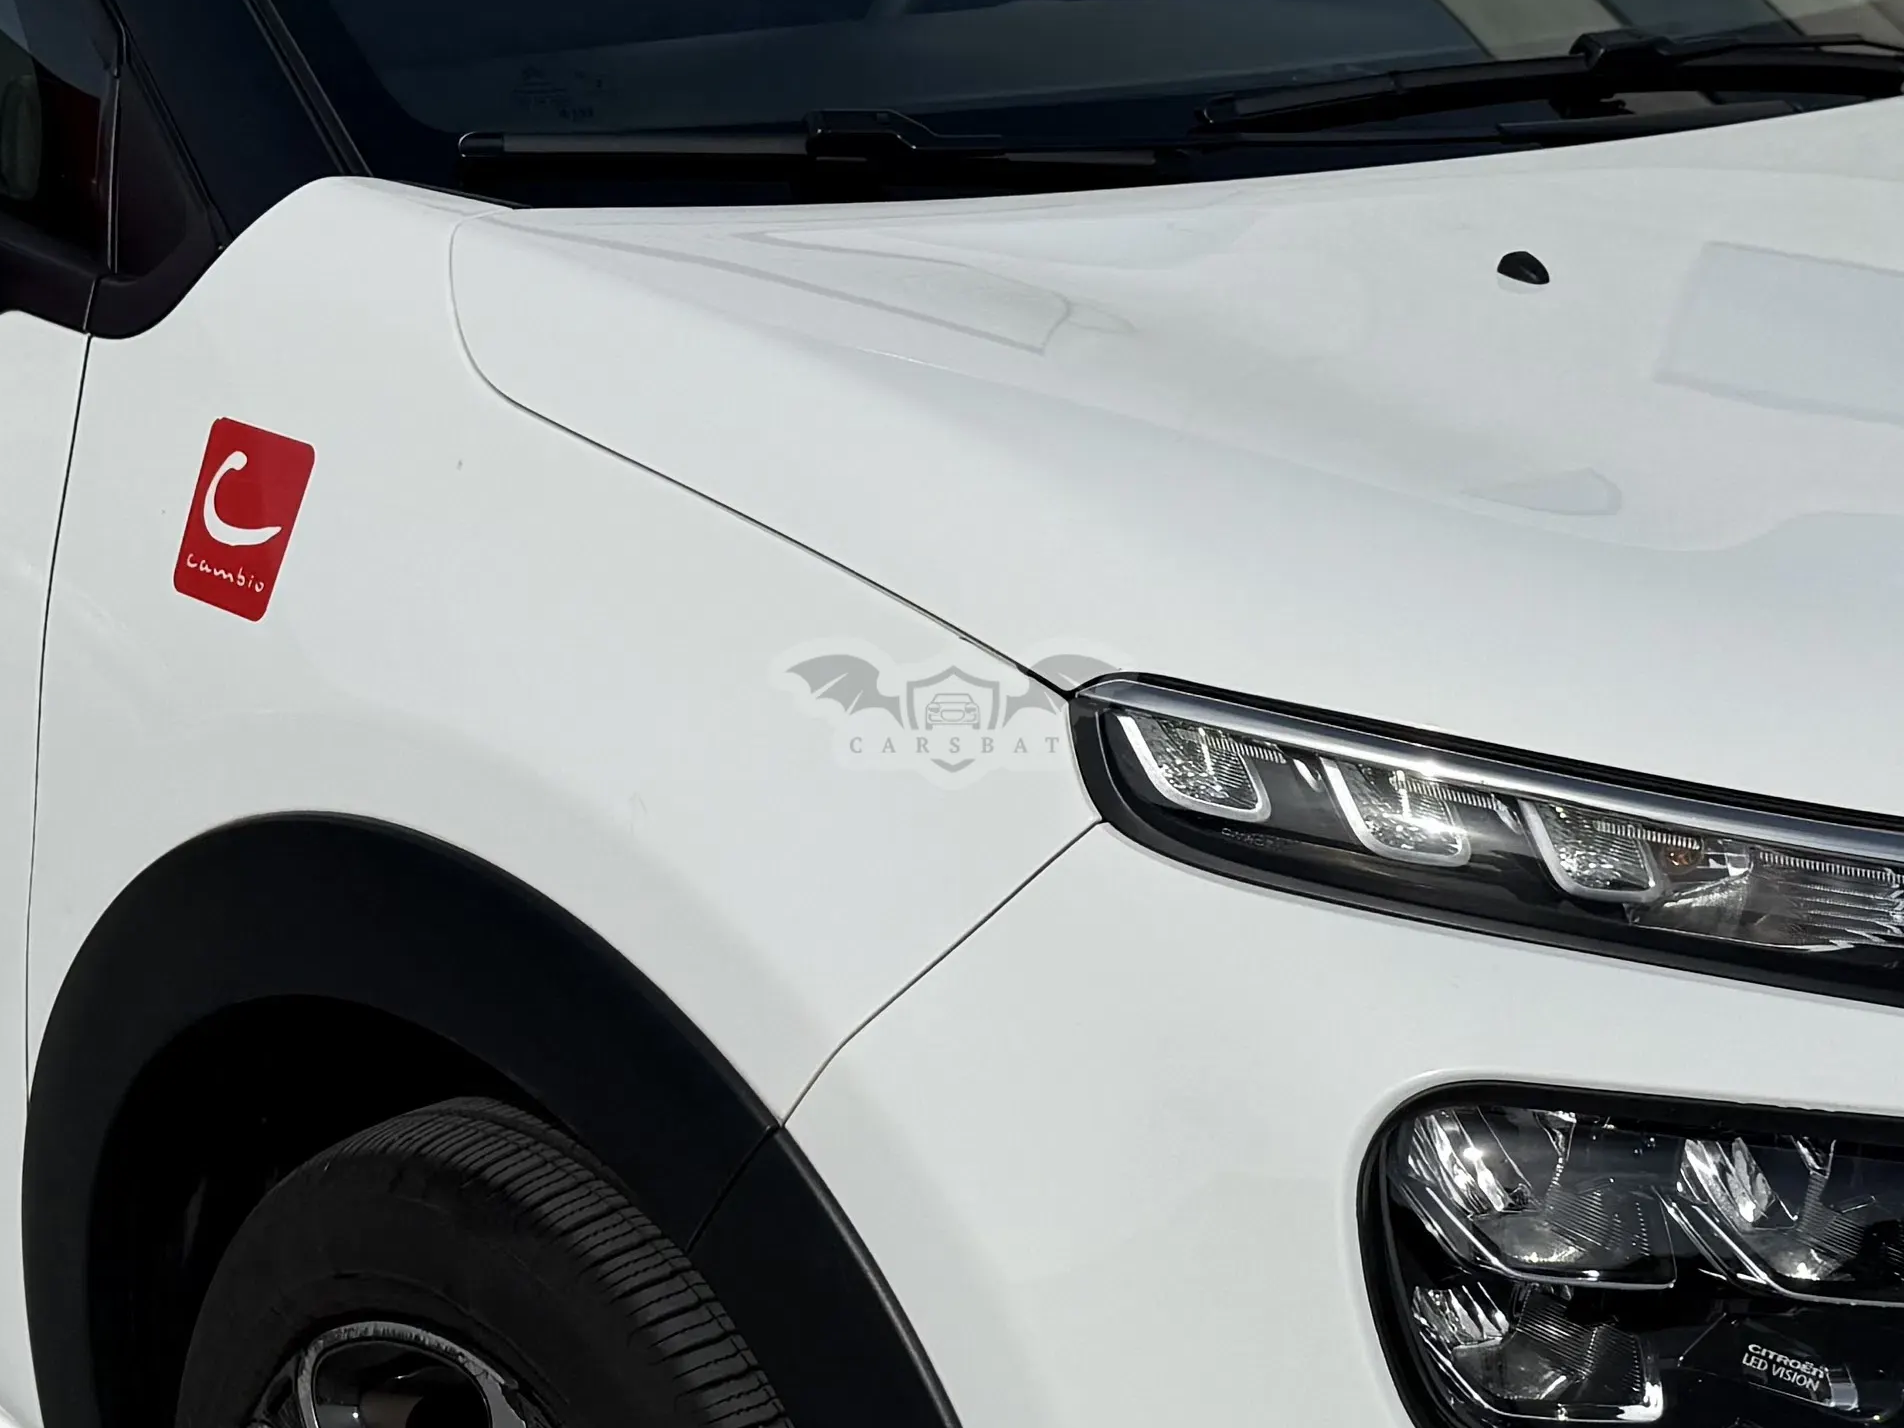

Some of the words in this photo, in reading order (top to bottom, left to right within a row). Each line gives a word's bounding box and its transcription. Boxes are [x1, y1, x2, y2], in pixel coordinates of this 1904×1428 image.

[186, 553, 265, 593] cambio
[1742, 1352, 1768, 1371] LED
[1771, 1363, 1820, 1392] VISION
